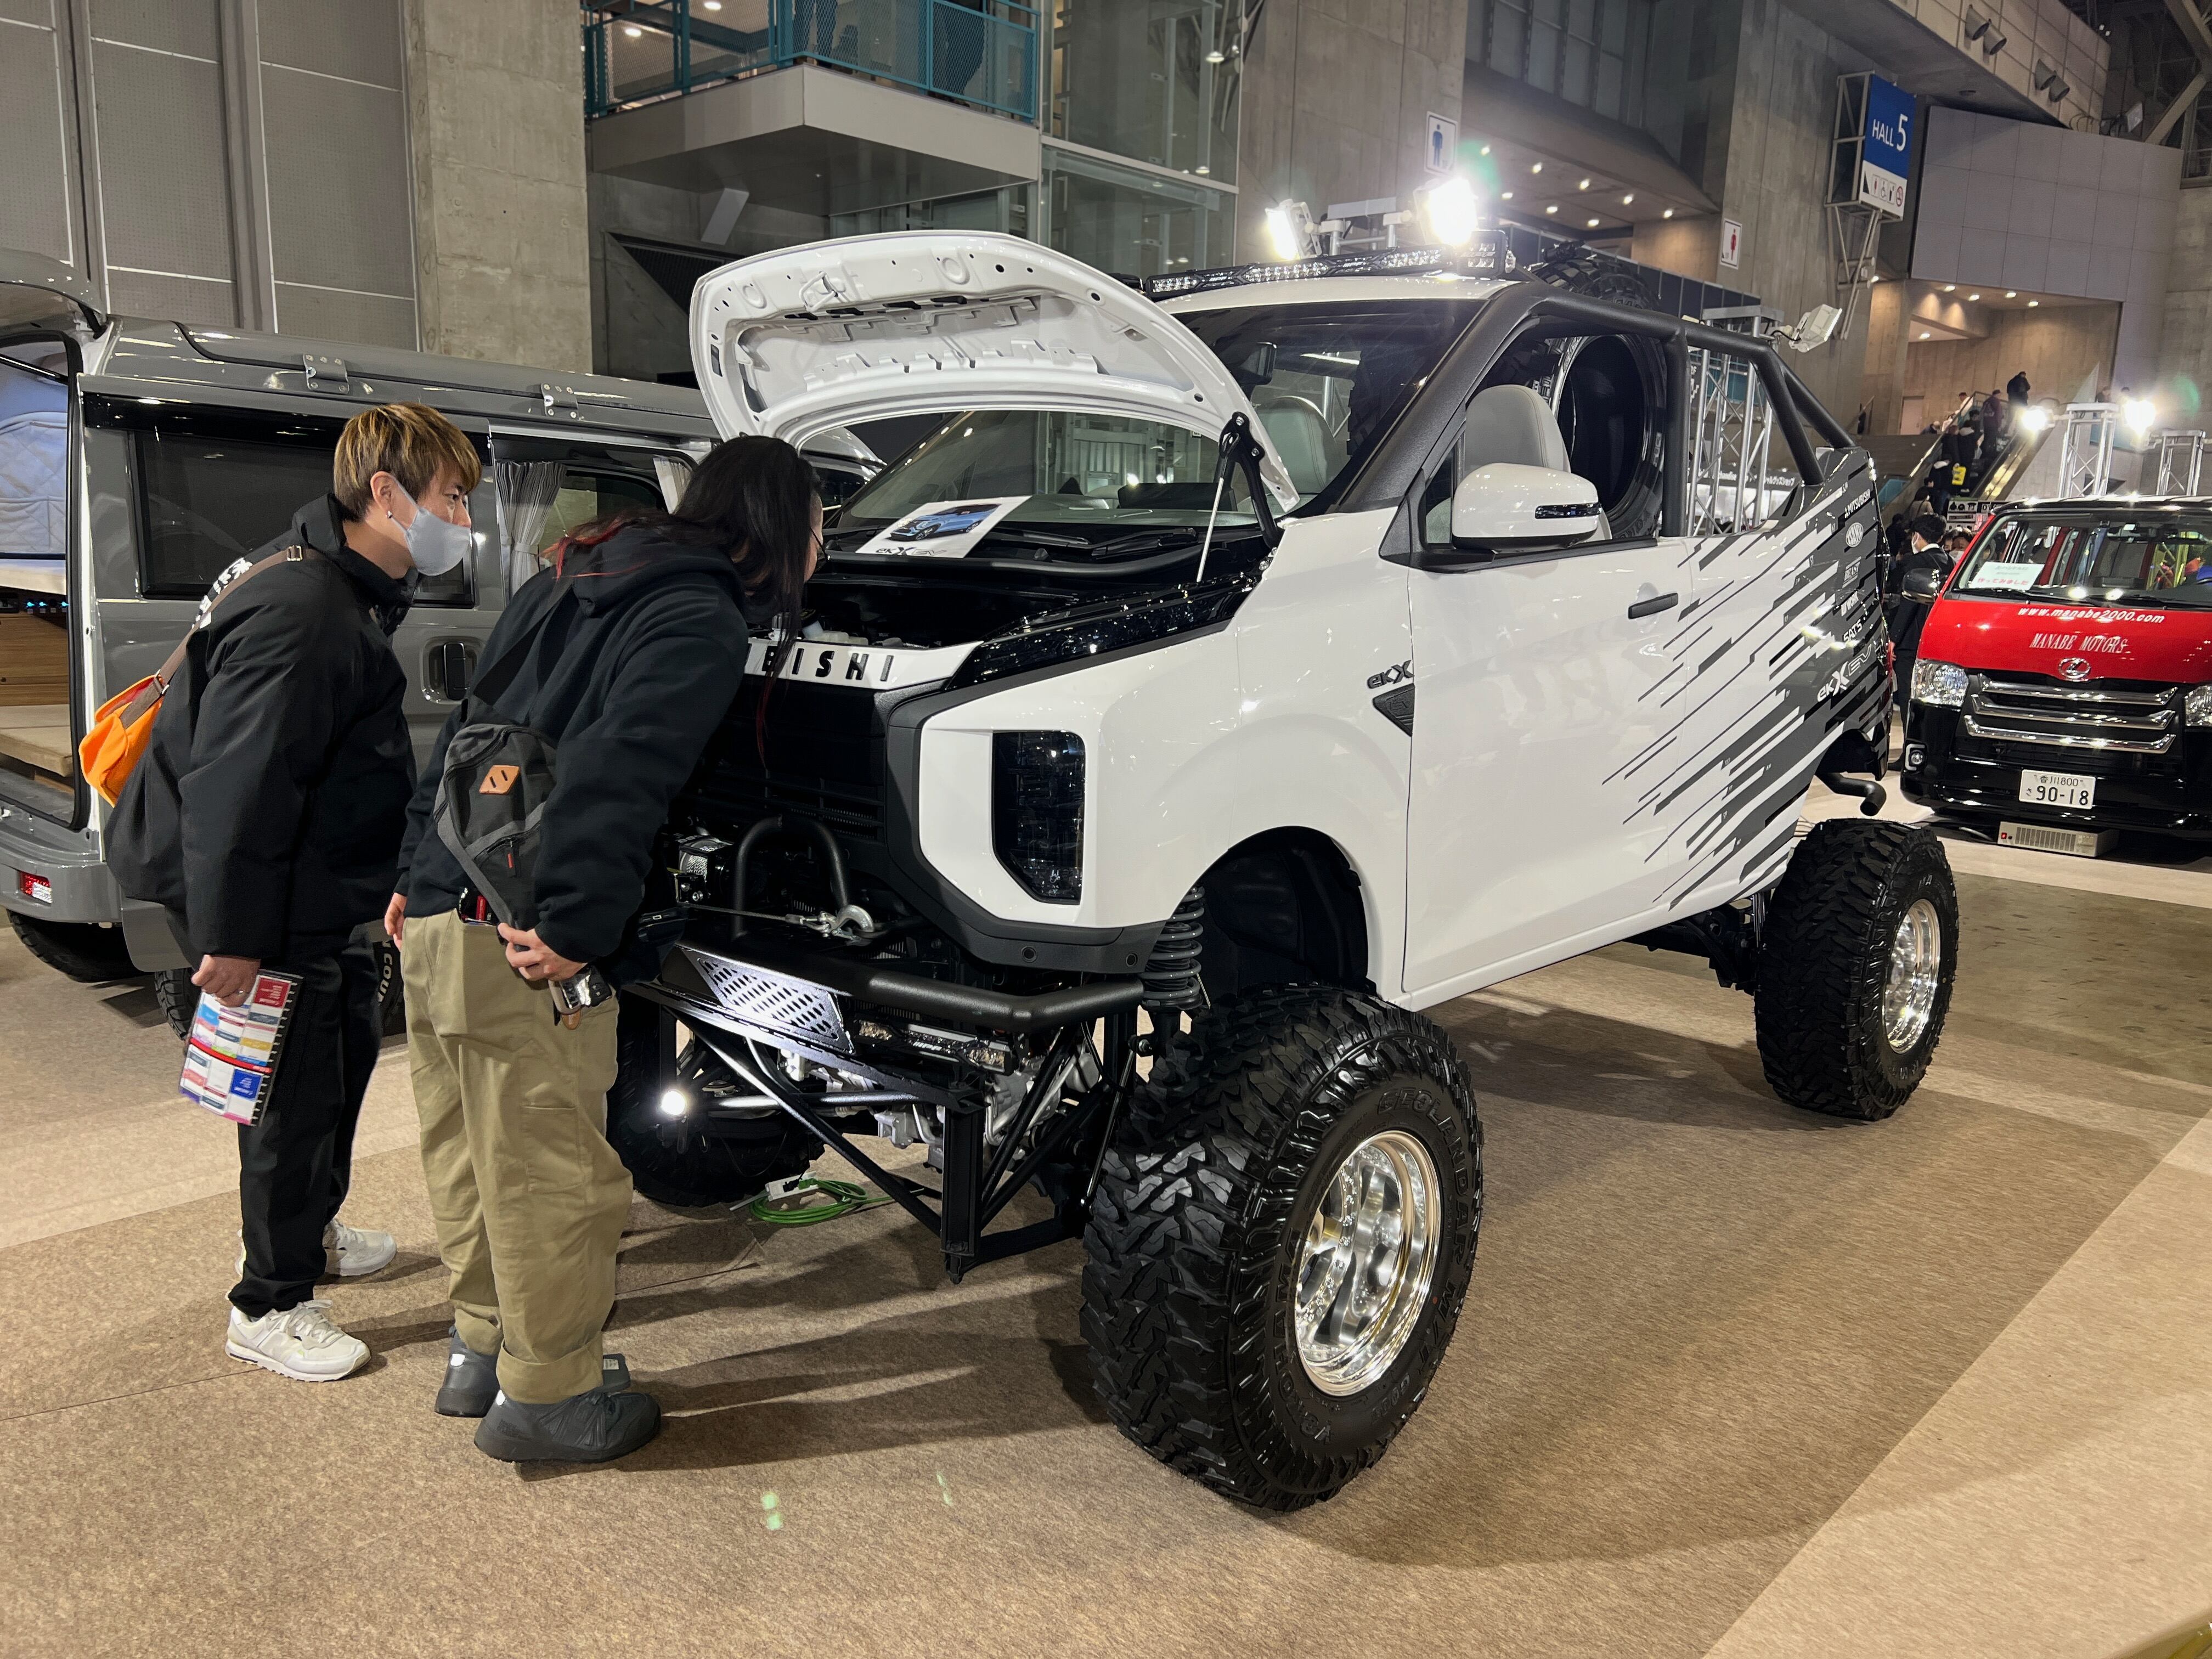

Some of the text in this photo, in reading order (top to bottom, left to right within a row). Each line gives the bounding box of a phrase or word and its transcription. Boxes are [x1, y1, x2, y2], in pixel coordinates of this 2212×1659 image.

[1872, 113, 1908, 151] HALL 5
[1847, 488, 1871, 516] MITSUBISHI
[2017, 607, 2165, 623] www.manabe2000.com
[2029, 633, 2129, 653] MANABE MOTORS
[760, 645, 894, 681] BISHI
[2036, 785, 2089, 806] 90-18
[1377, 1086, 1470, 1266] GEOLANDAR
[1272, 1227, 1332, 1445] YOKOHAMA
